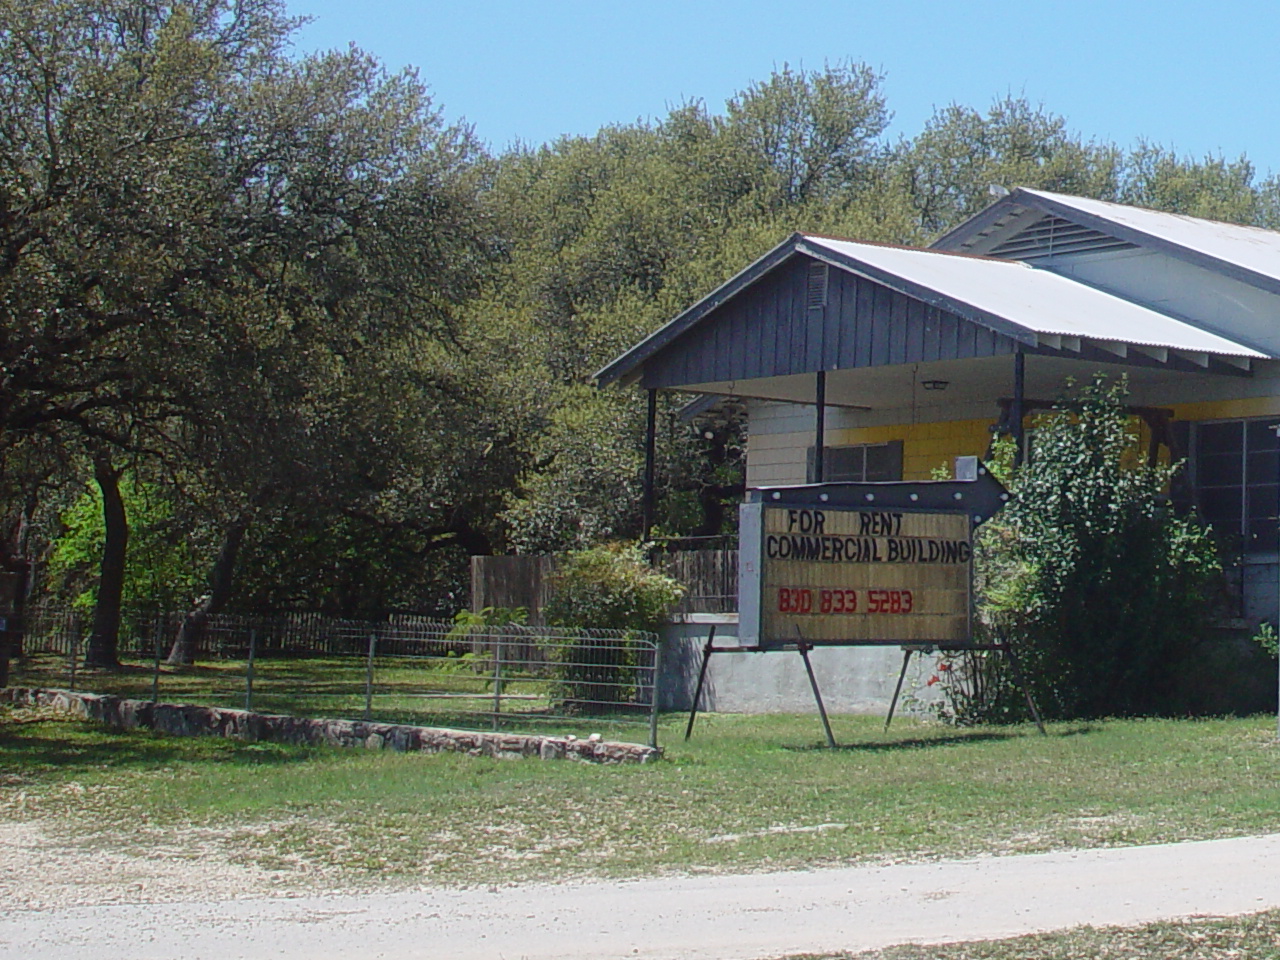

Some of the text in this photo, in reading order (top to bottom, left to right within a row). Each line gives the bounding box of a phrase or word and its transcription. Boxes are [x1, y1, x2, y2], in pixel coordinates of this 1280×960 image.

[788, 510, 903, 536] FOR RENT
[766, 535, 971, 564] COMMERCIAL BUILDING
[819, 590, 857, 614] 833
[867, 590, 913, 614] 5283
